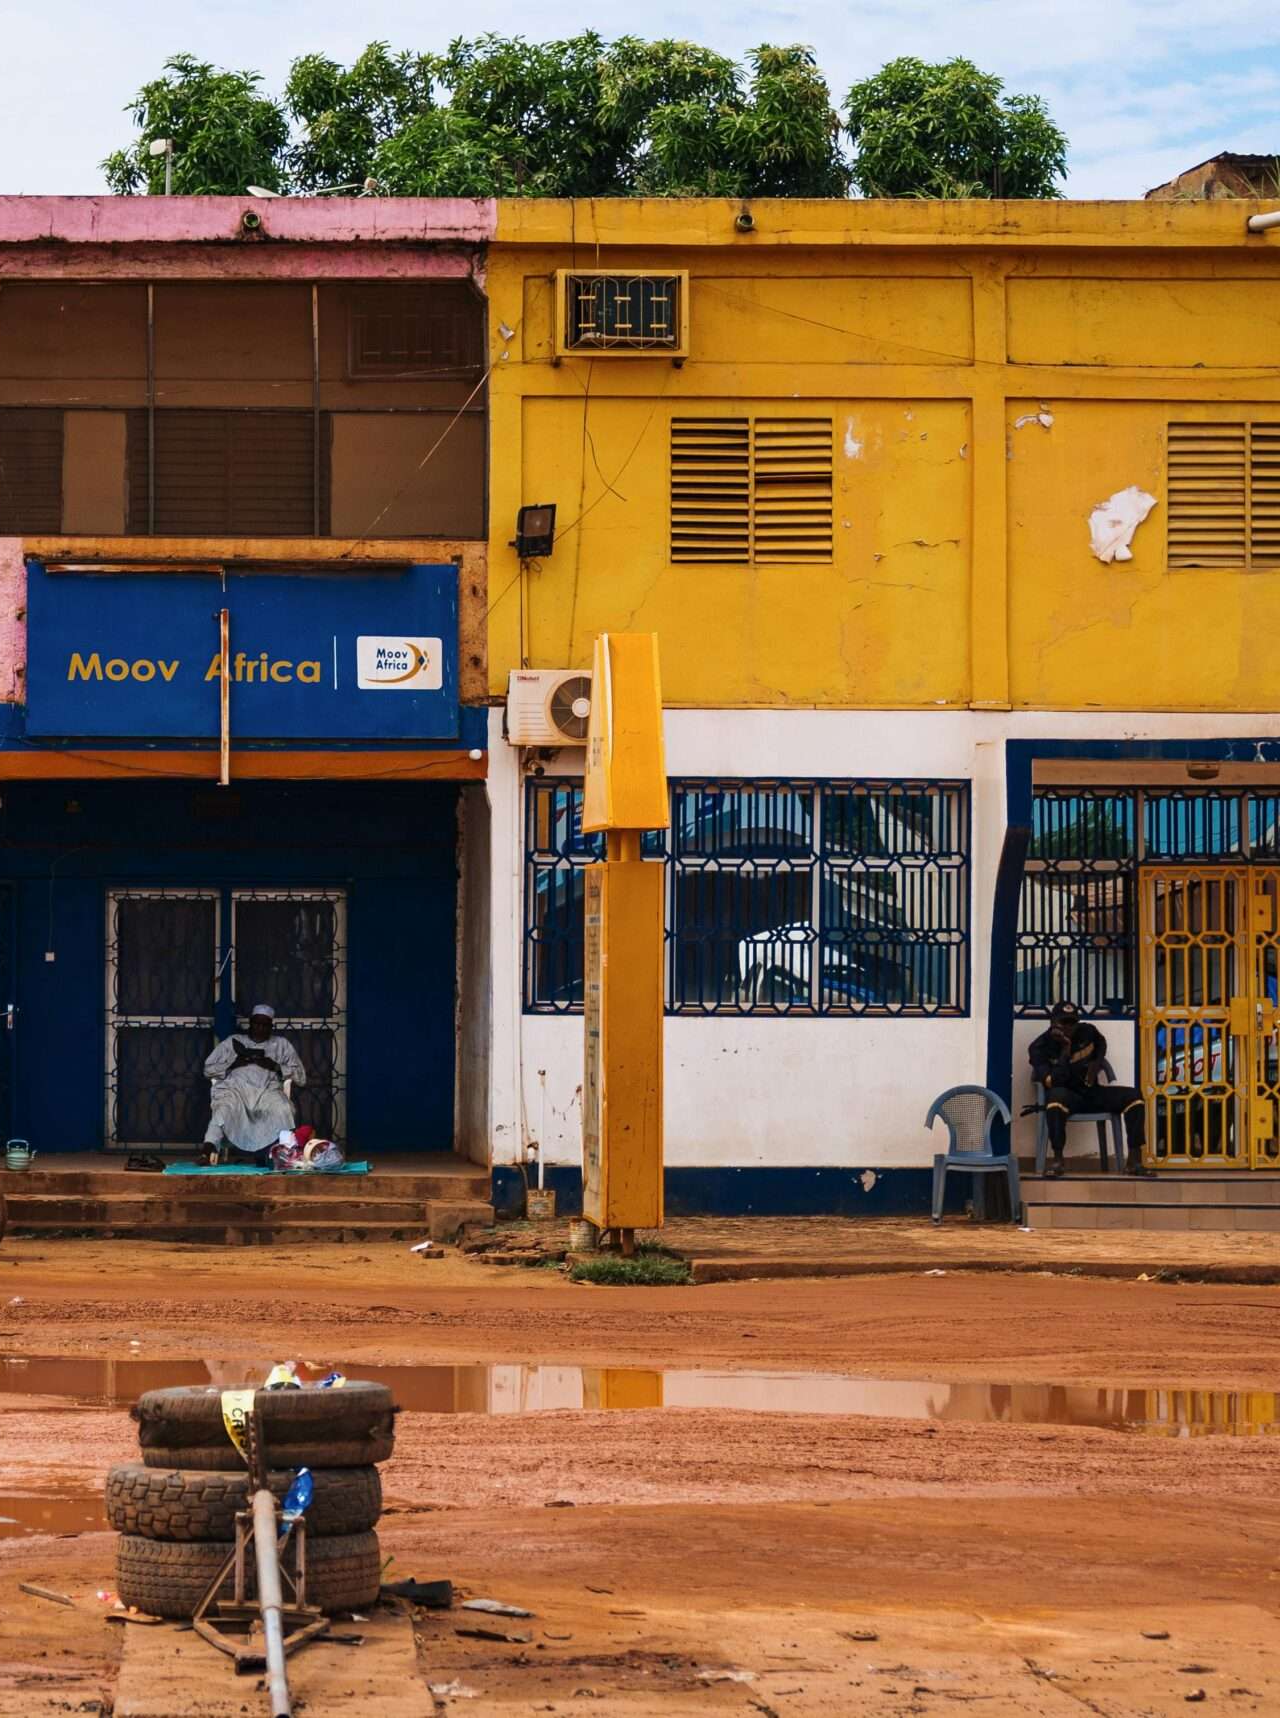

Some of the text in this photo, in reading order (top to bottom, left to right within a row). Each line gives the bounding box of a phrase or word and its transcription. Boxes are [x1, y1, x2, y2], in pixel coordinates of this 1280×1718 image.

[376, 648, 408, 659] Moov
[67, 652, 321, 683] Moov Africa
[376, 659, 408, 670] Africa
